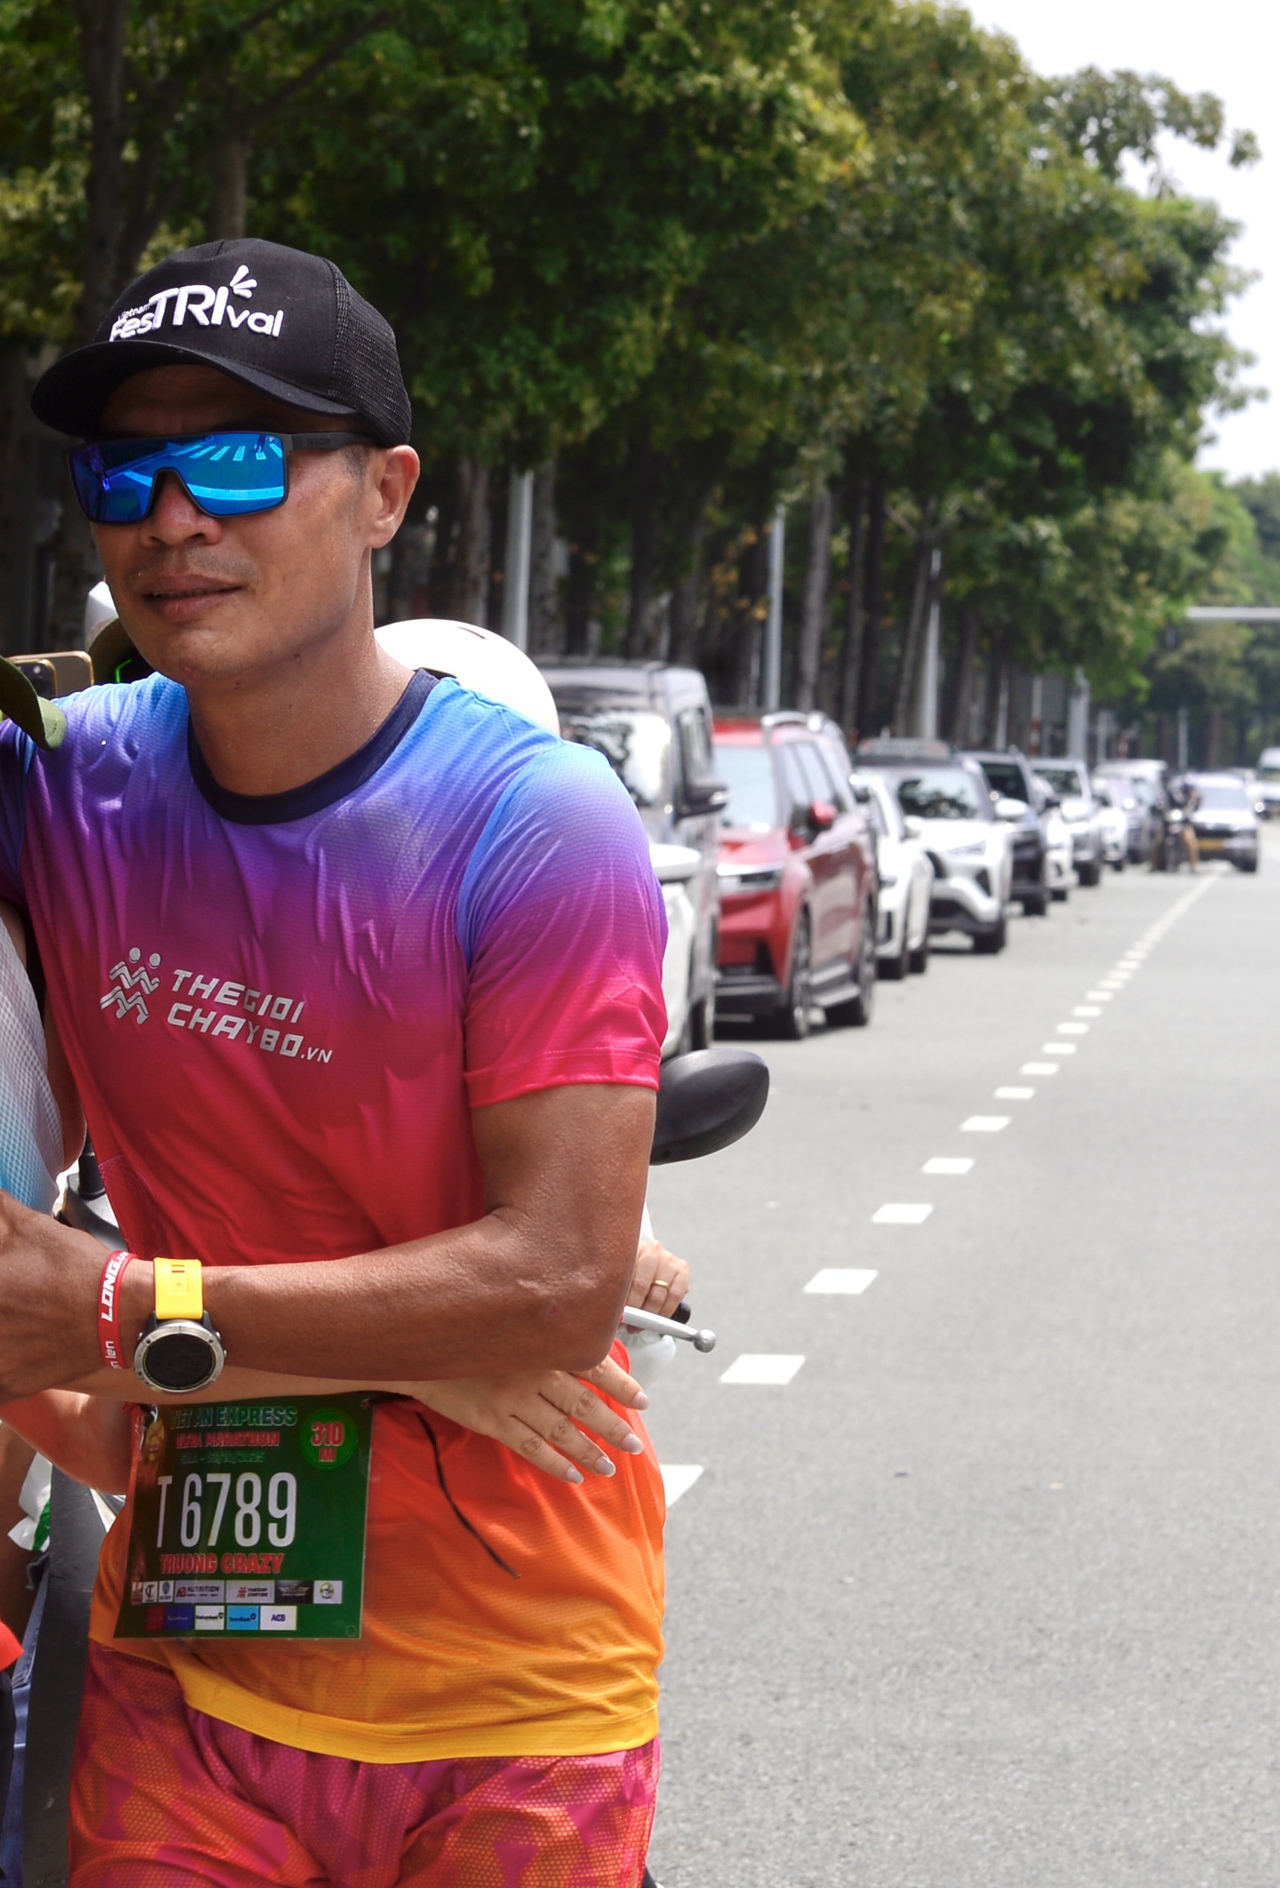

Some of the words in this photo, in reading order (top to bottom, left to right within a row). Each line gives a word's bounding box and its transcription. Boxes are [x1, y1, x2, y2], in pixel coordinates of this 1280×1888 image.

[172, 969, 305, 1023] THEGIOI
[216, 1405, 298, 1427] EXPRESS
[205, 1431, 280, 1447] MARATHON
[310, 1421, 345, 1446] 310
[180, 1472, 297, 1548] 6789
[160, 1553, 218, 1575] TRUONG
[221, 1552, 285, 1574] CRAZY
[271, 1614, 286, 1622] ACB
